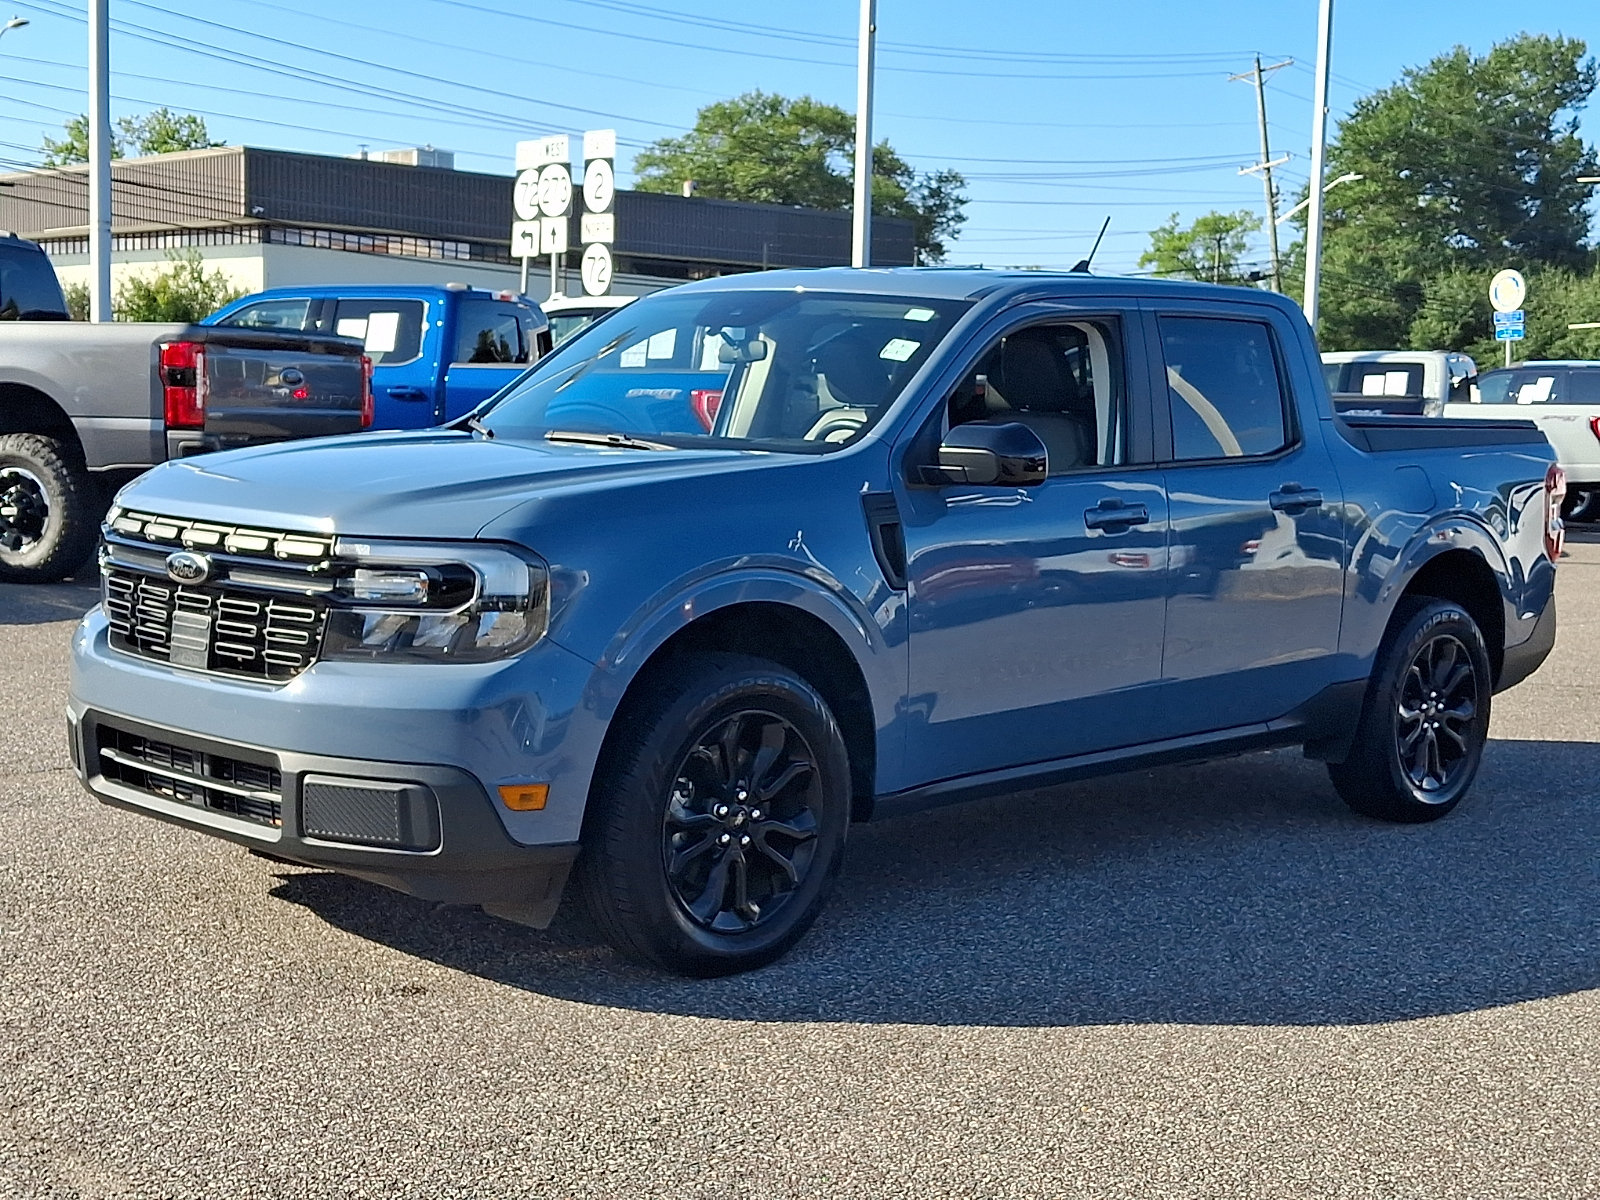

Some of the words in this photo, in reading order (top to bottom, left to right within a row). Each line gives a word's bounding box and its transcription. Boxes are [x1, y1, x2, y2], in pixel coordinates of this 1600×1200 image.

[520, 182, 539, 207] 72
[542, 176, 567, 204] 273
[594, 173, 603, 200] 2
[587, 256, 607, 283] 72
